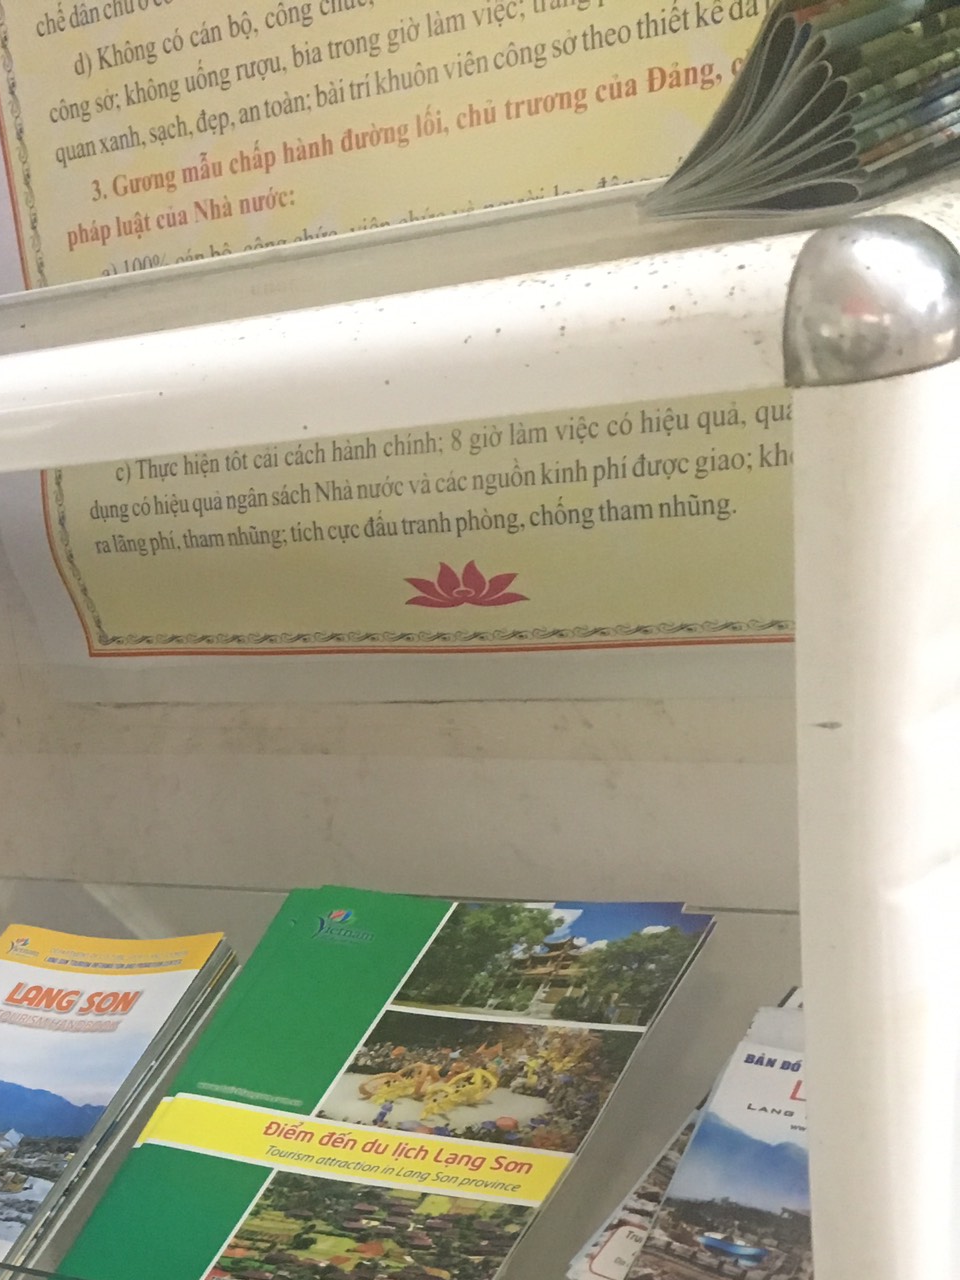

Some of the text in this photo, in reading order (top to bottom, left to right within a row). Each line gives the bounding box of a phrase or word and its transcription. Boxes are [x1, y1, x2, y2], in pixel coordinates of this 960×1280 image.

[112, 168, 176, 198] Gương
[182, 152, 224, 185] mẫu
[229, 140, 276, 175] chấp
[283, 133, 334, 164] hành
[340, 124, 410, 153] đường
[456, 99, 497, 130] chủ
[505, 87, 588, 122] trương
[595, 74, 638, 104] của
[67, 218, 111, 252] pháp
[116, 211, 151, 240] luật
[155, 204, 189, 231] của
[193, 195, 233, 224] Nhà
[90, 500, 130, 524] dụng
[132, 496, 152, 516] có
[153, 490, 190, 518] hiệu
[192, 489, 223, 518] quả
[226, 486, 269, 514] ngân
[271, 482, 312, 507] sách
[315, 478, 354, 502] Nhà
[356, 475, 404, 500] nước
[408, 473, 432, 495] và
[435, 472, 467, 495] các
[471, 458, 537, 496] nguồn
[541, 459, 589, 487] kinh
[592, 455, 628, 488] phí
[632, 452, 690, 482] được
[95, 538, 112, 555] ra
[112, 533, 147, 557] lãng
[183, 527, 226, 549] tham
[291, 521, 325, 543] tích
[327, 519, 361, 542] cực
[363, 509, 398, 538] đấu
[401, 512, 451, 536] tranh
[529, 496, 595, 530] chống
[599, 498, 654, 523] tham
[5, 981, 141, 1015] LANG SON
[746, 1102, 795, 1117] LANG
[265, 1144, 315, 1163] Tourism
[316, 1155, 381, 1173] attraction
[381, 1165, 394, 1174] in
[434, 1171, 458, 1186] Son
[458, 1175, 521, 1193] province
